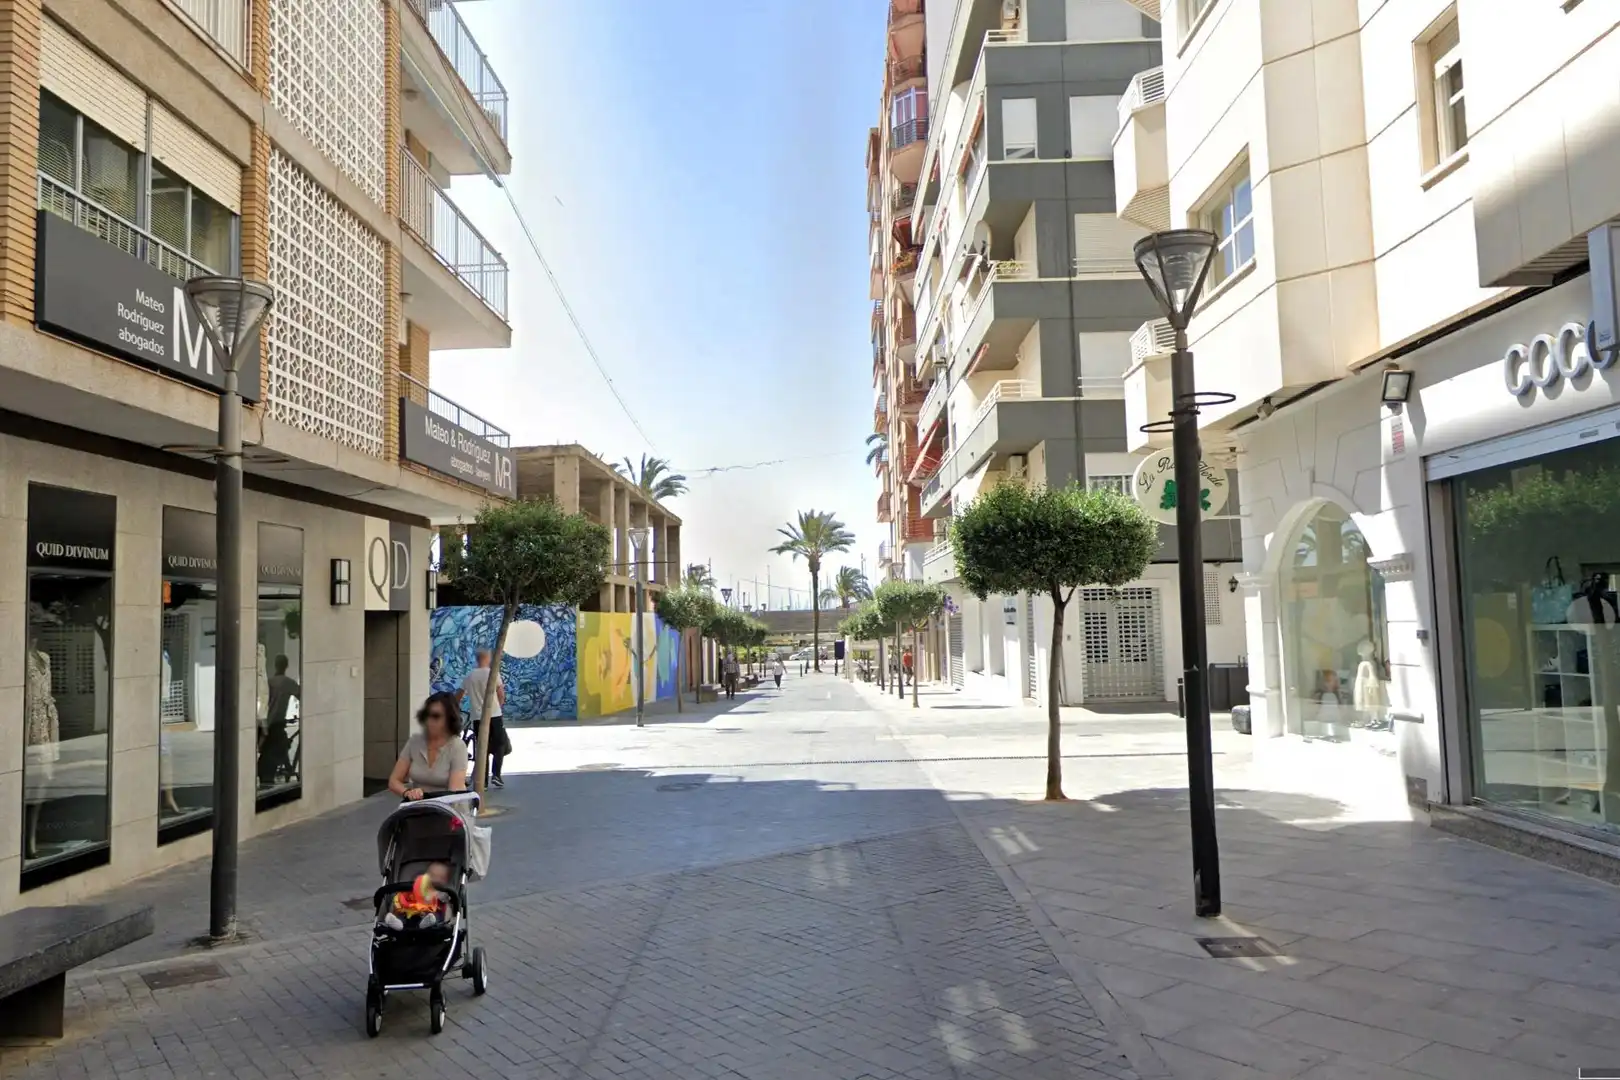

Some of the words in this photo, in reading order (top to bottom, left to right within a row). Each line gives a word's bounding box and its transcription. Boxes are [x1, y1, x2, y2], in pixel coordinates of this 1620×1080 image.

[135, 288, 165, 314] Mateo
[117, 302, 165, 335] Rodriguez
[118, 327, 165, 356] abogados
[425, 415, 449, 445] Mateo
[450, 429, 457, 448] &
[495, 452, 512, 491] MR
[1138, 471, 1156, 494] La
[36, 541, 64, 558] QUID
[65, 543, 109, 561] DIVINUM
[168, 554, 188, 569] QUID
[368, 536, 410, 603] QD
